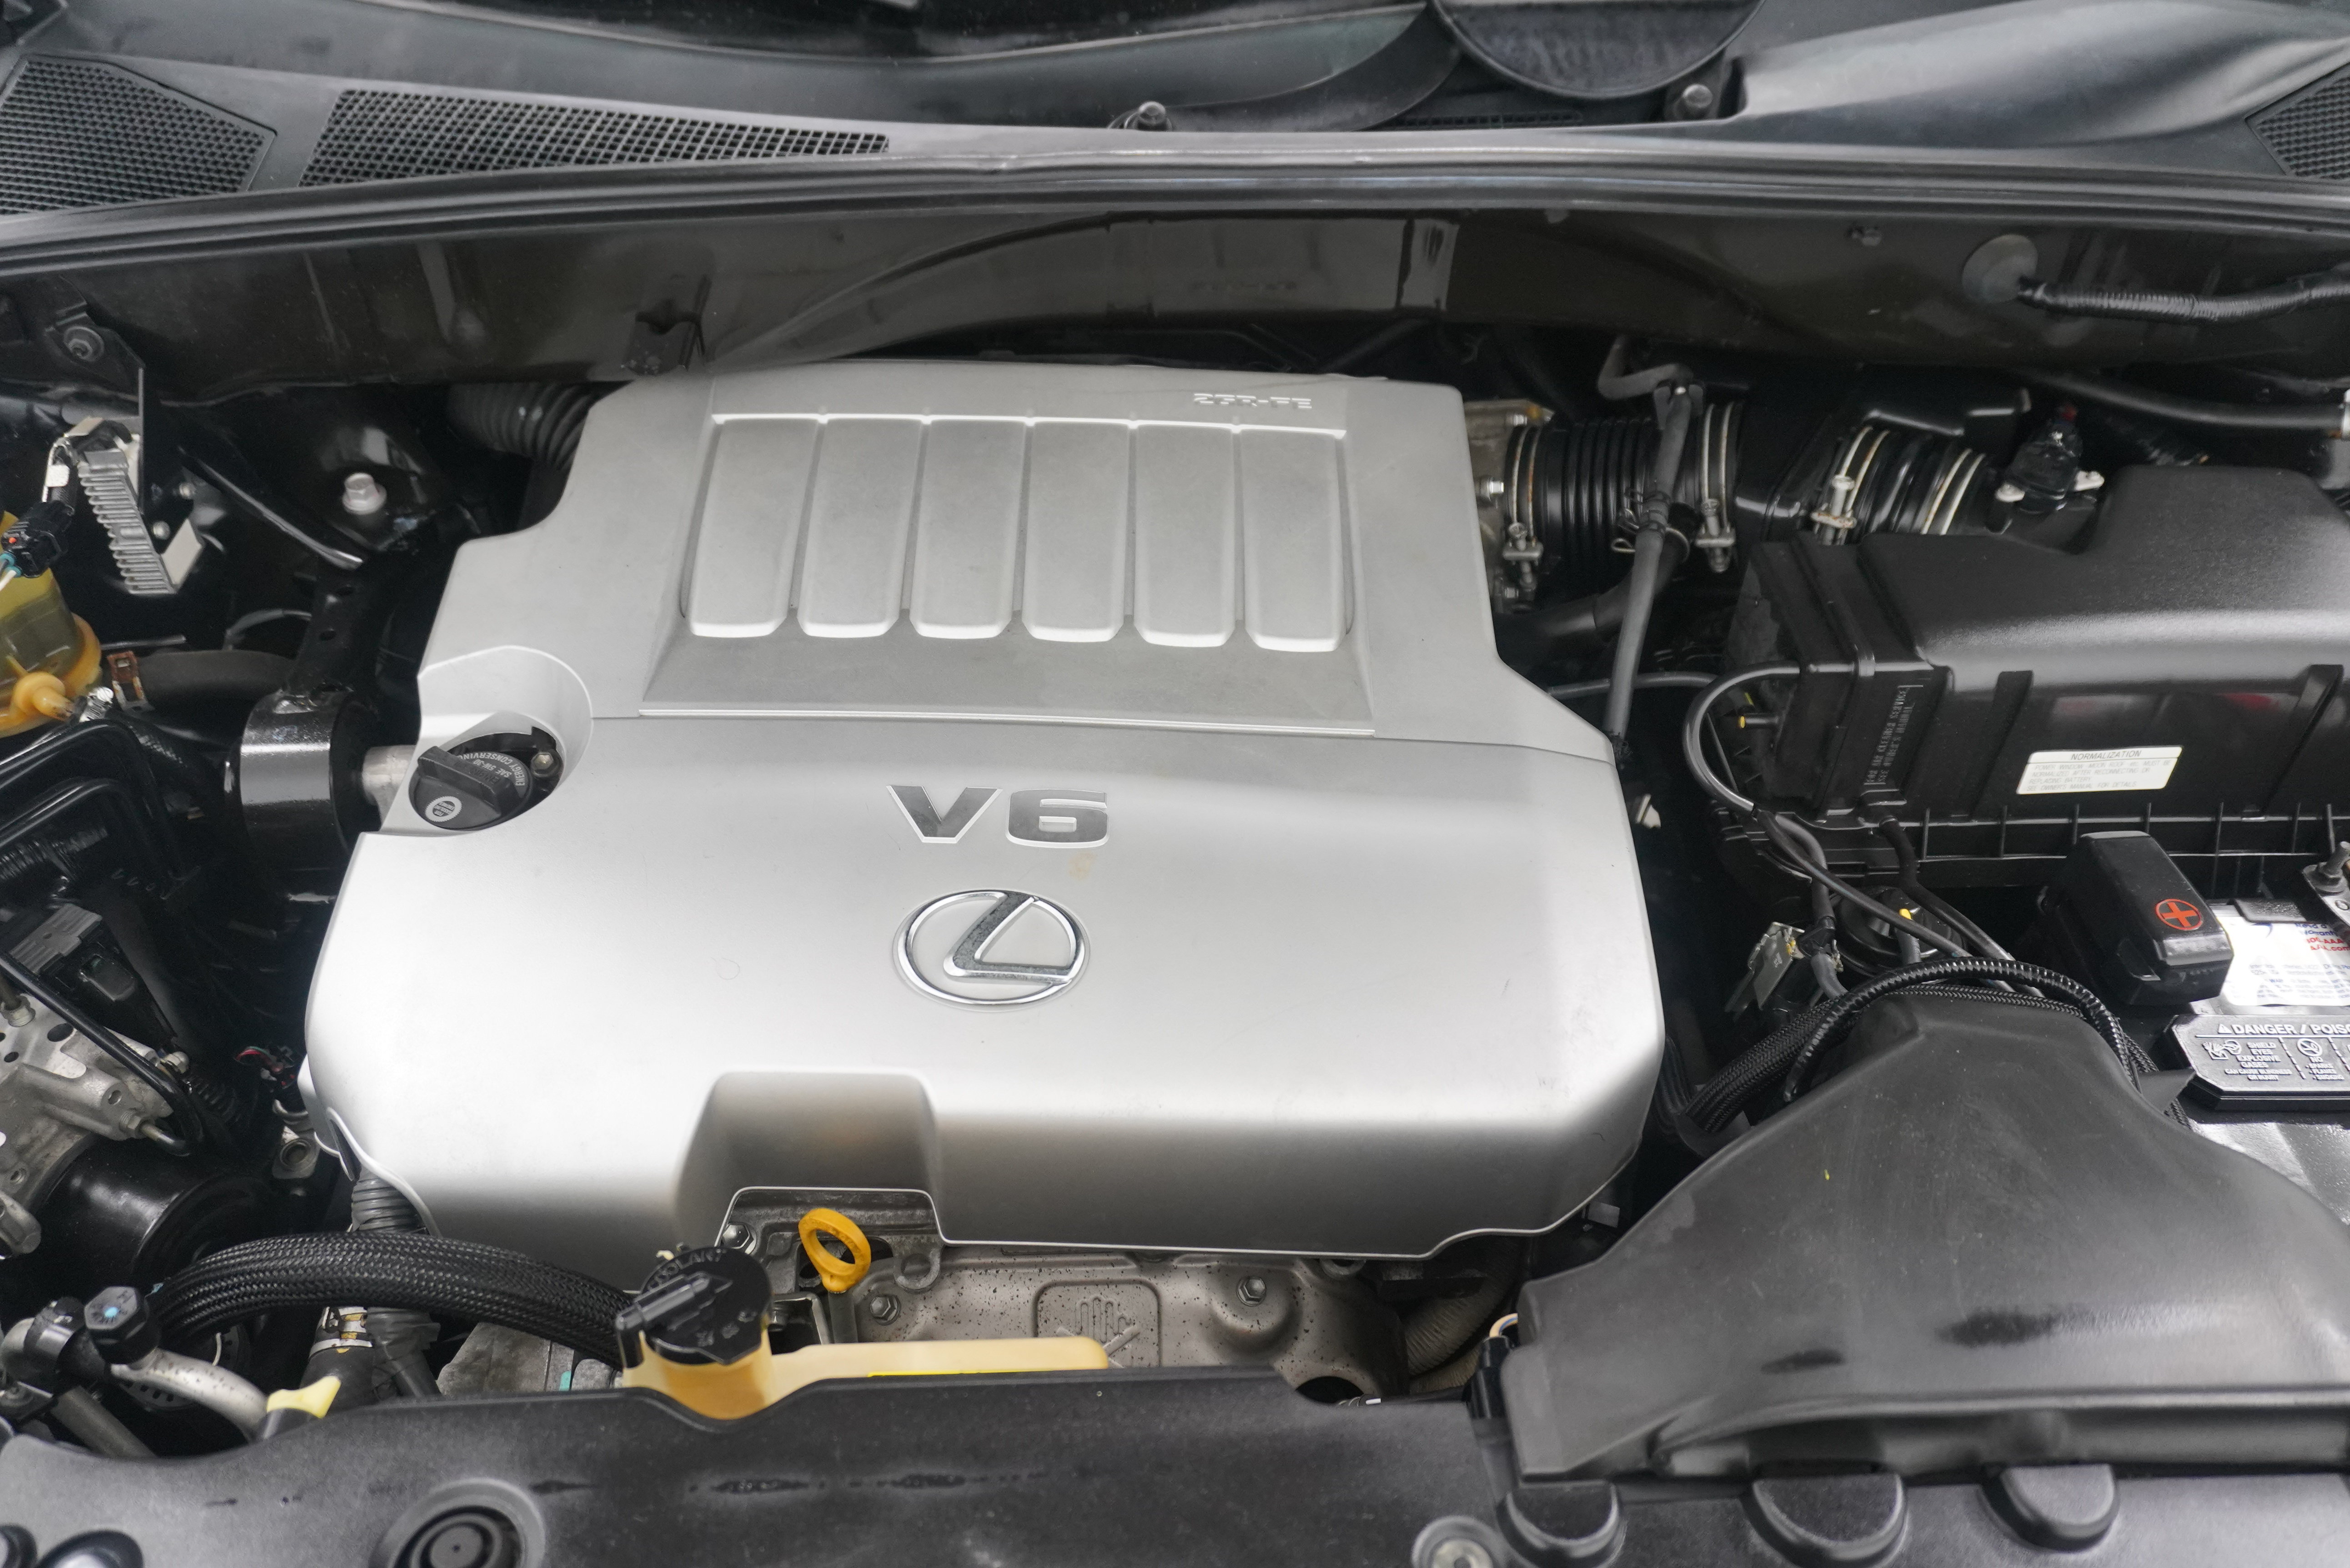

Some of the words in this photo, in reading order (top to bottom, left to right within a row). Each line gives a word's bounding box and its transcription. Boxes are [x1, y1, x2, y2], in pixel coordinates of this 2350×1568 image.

[2071, 750, 2142, 760] NORMALIZATION
[473, 759, 497, 771] 5W-30
[495, 768, 512, 778] SAE
[509, 764, 525, 786] ENERGY
[886, 784, 1110, 849] V6
[2231, 1024, 2298, 1035] DANGER
